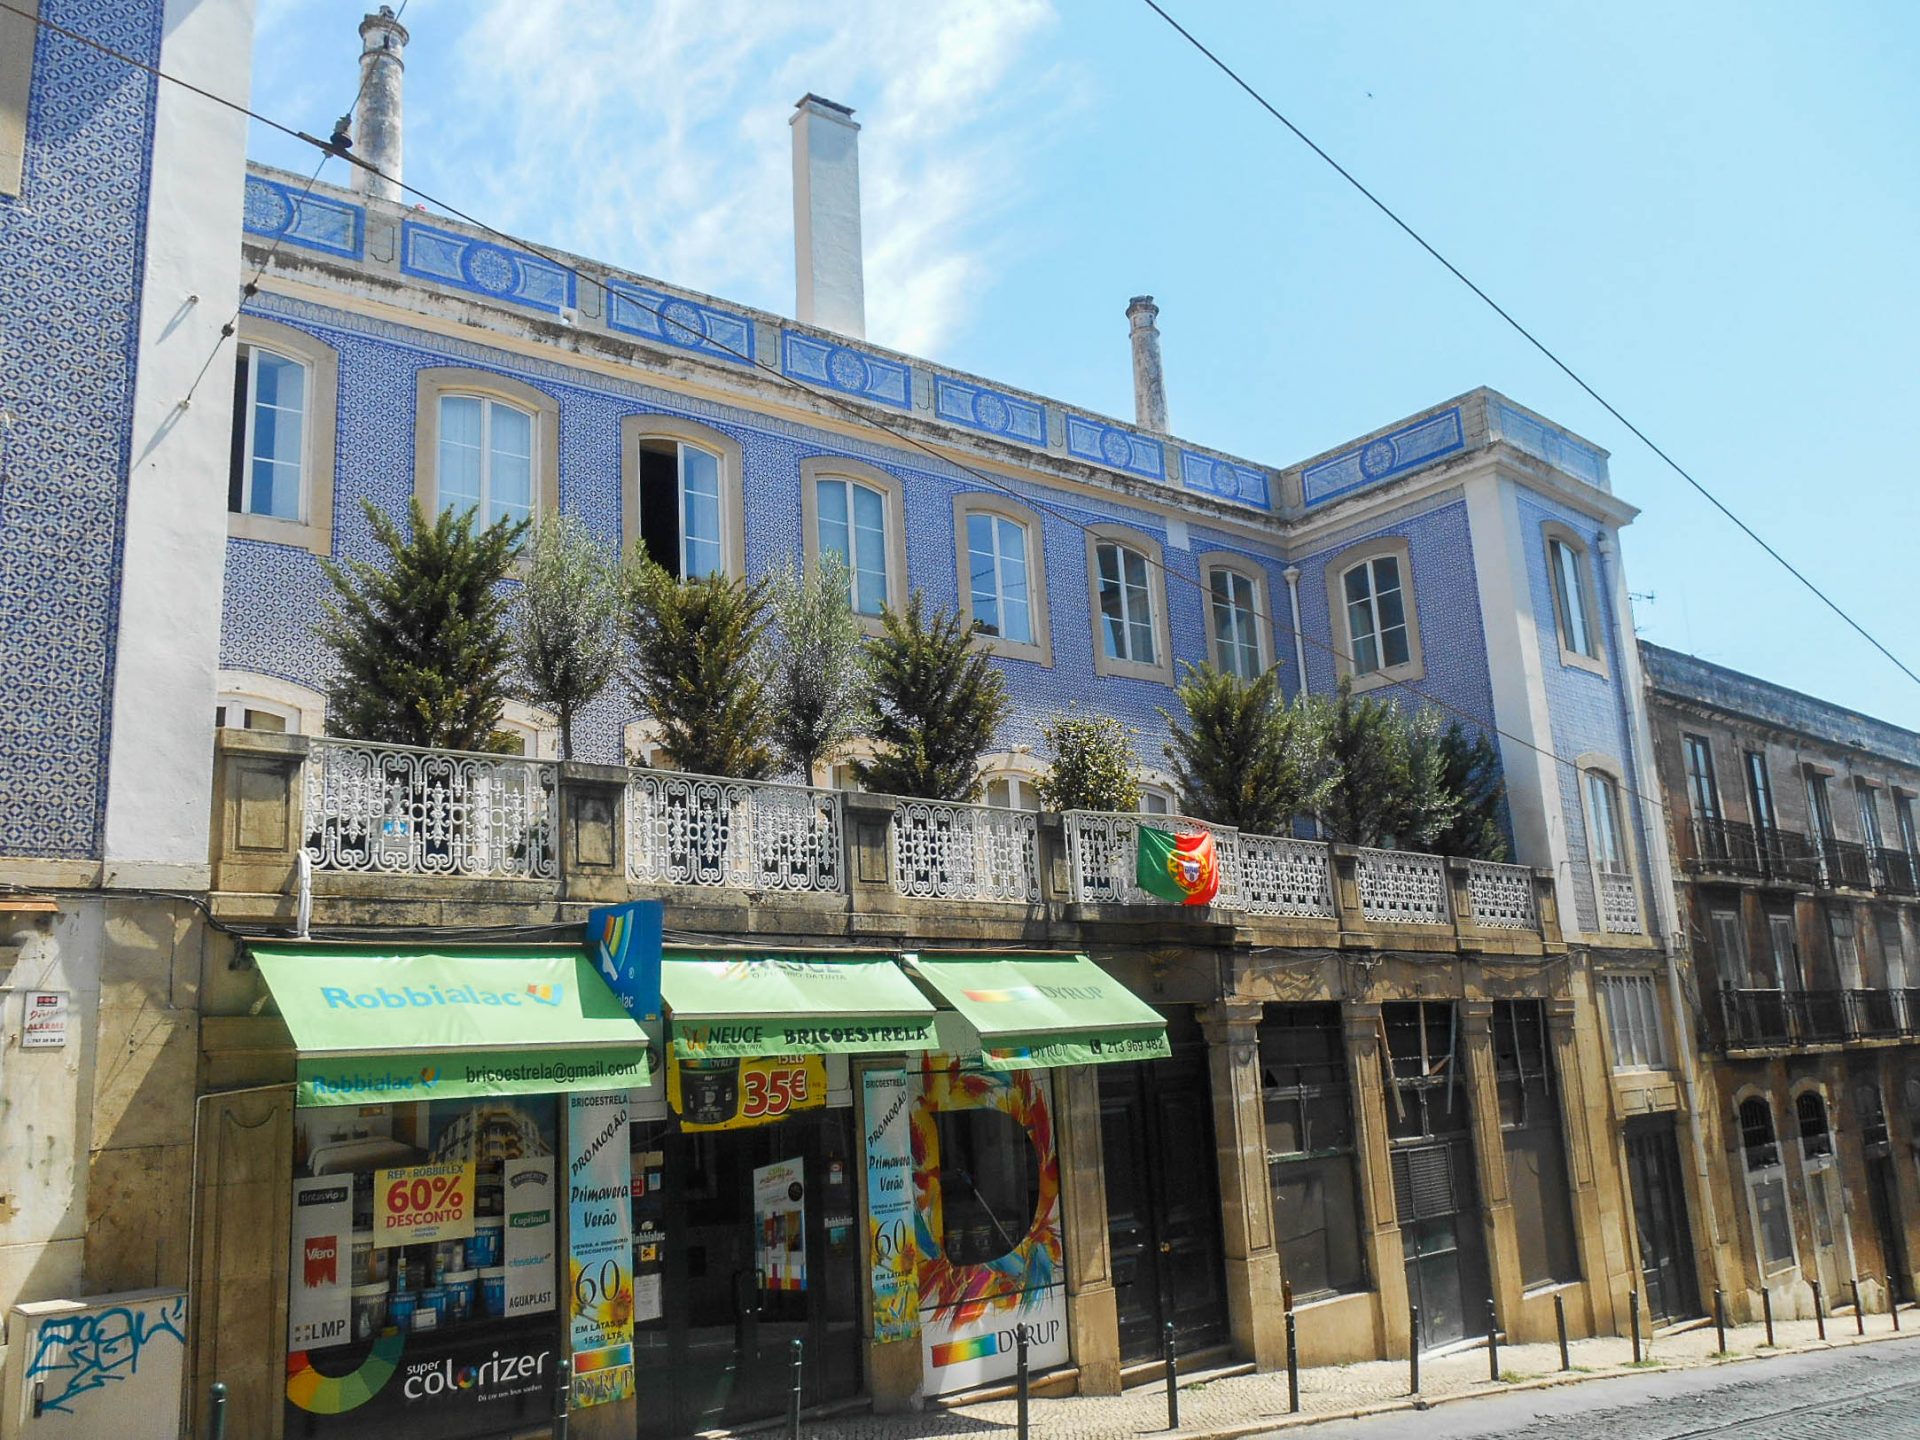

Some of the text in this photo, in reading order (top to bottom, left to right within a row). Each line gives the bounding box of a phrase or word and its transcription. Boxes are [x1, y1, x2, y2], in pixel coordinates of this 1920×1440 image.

[321, 984, 522, 1009] Robbialac
[1033, 984, 1104, 1000] DYRUP
[708, 1026, 763, 1044] NEUCE
[784, 1026, 929, 1045] BRICOESTRELA
[1030, 1044, 1068, 1060] DYRUP
[1107, 1038, 1164, 1054] 213 969 482
[466, 1060, 637, 1084] bricoestrela@gmail.com
[312, 1071, 414, 1096] Robbialac
[743, 1069, 807, 1117] 35€
[571, 1095, 628, 1108] BRICOESTRELA
[867, 1090, 907, 1148] PROMOÇÃO
[571, 1108, 627, 1177] PROMOÇÃO
[387, 1170, 406, 1180] REP
[879, 1175, 904, 1192] Verão
[386, 1176, 464, 1214] 60%
[571, 1185, 629, 1204] Primavera
[386, 1209, 463, 1229] DESCONTO
[584, 1208, 617, 1228] Verão
[875, 1218, 906, 1257] 60
[575, 1259, 620, 1306] 60
[509, 1292, 552, 1309] AGUAPLAST
[312, 1319, 346, 1340] LMP
[575, 1324, 589, 1334] EM
[590, 1320, 616, 1332] LATAS
[403, 1350, 550, 1399] colorizer
[407, 1360, 440, 1375] super
[574, 1368, 633, 1398] DYRUP
